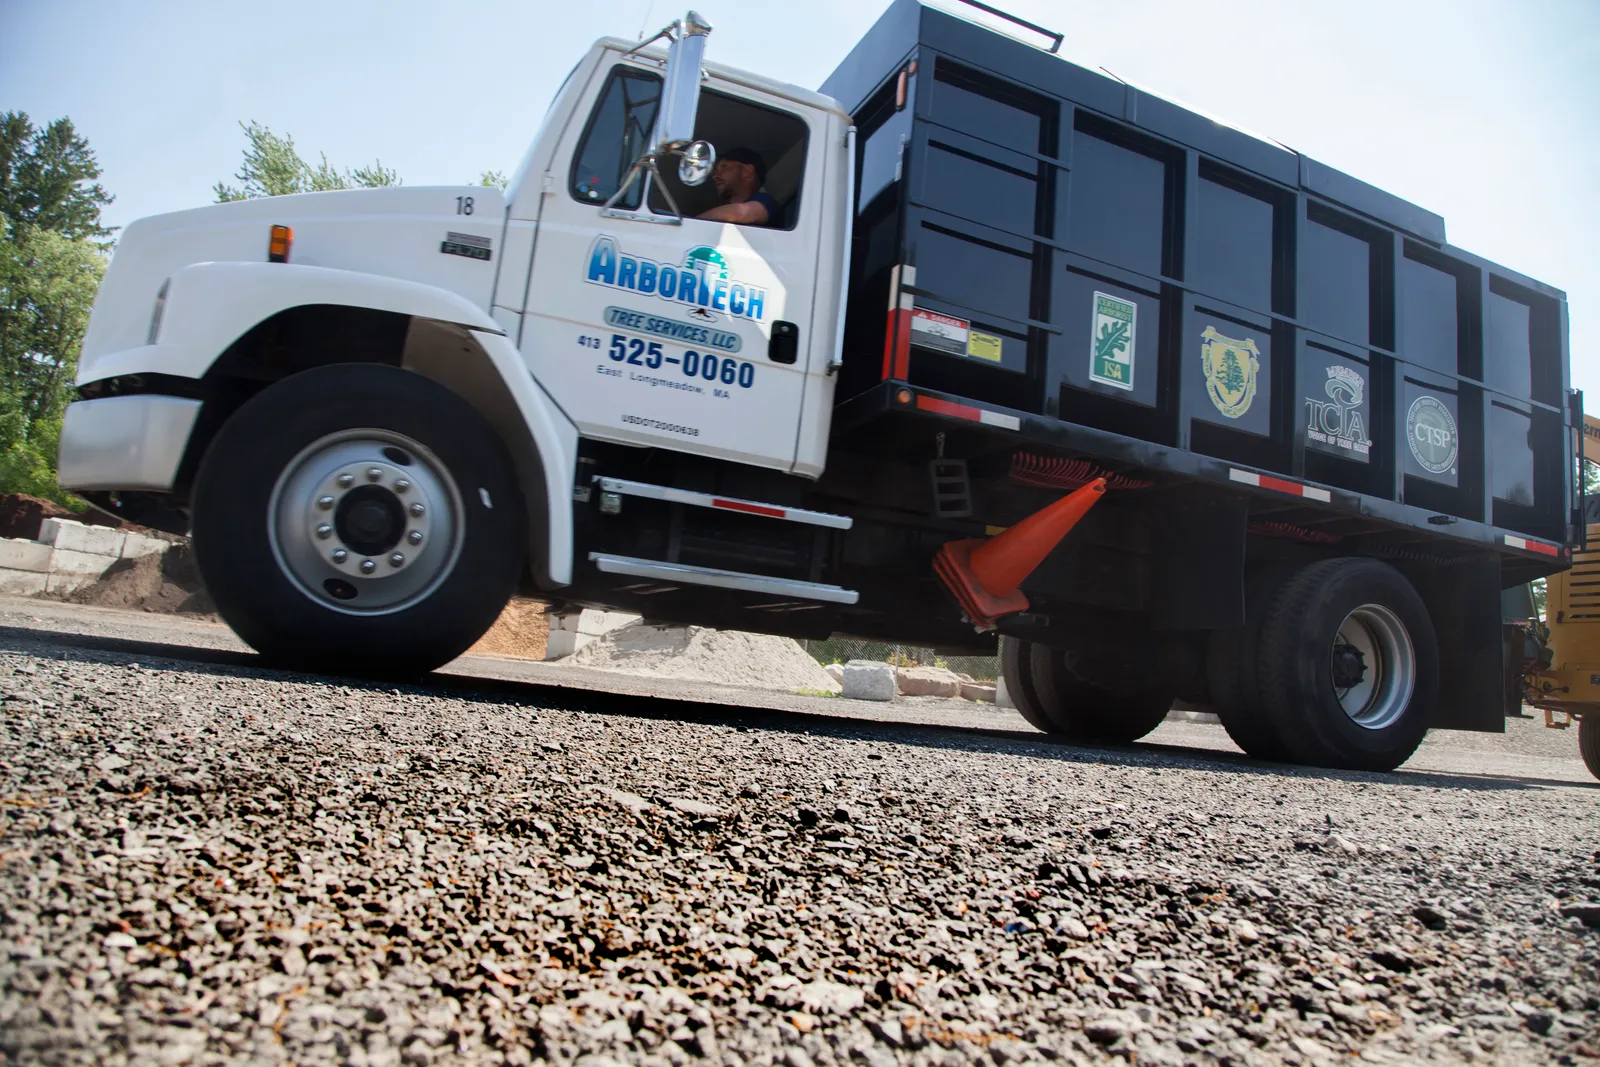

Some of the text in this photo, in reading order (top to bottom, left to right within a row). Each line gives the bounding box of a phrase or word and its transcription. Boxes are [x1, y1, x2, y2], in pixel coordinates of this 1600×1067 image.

[455, 196, 474, 216] 18
[1098, 296, 1133, 314] CERTIFIED
[1098, 306, 1132, 323] ARBORIST
[610, 309, 644, 325] TREE
[712, 333, 736, 349] LLC
[577, 334, 755, 389] 413 525-0060
[1103, 361, 1122, 380] ISA
[597, 365, 622, 378] East
[713, 388, 730, 400] MA
[1305, 394, 1369, 445] TCIA
[1415, 423, 1451, 448] CTSP
